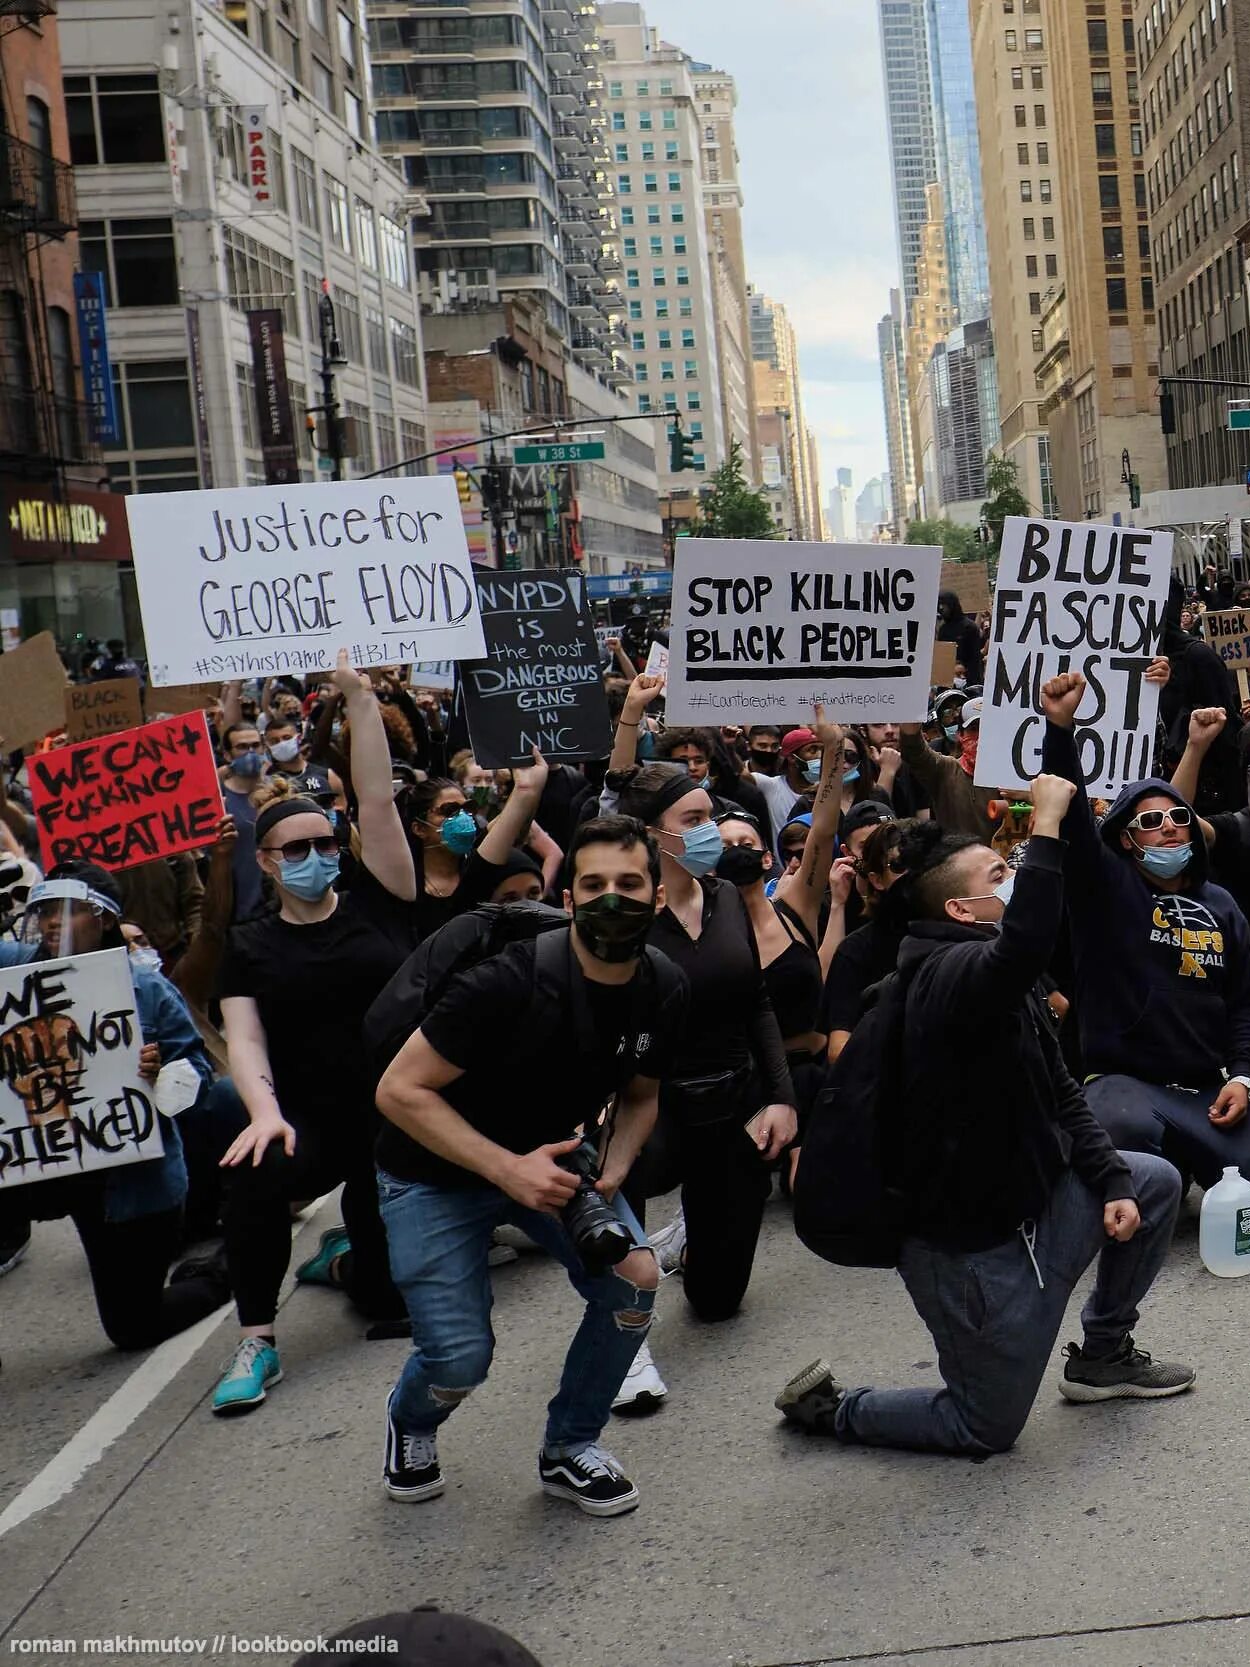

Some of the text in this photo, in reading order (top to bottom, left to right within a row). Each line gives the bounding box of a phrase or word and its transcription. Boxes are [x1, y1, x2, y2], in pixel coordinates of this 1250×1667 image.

[248, 131, 266, 186] PARK
[260, 320, 282, 436] LOVE WHERE YOU LEASE
[538, 446, 581, 460] W 38 St
[373, 494, 444, 544] for
[1017, 523, 1152, 587] BLUE
[200, 562, 474, 641] GEORGE FLOYD
[688, 575, 773, 617] STOP
[791, 567, 915, 614] KILLING
[517, 618, 545, 639] is
[686, 625, 786, 665] BLACK
[799, 620, 920, 665] PEOPLE!
[994, 590, 1168, 657] FASCISM
[1207, 613, 1248, 637] Black
[351, 640, 419, 667] #BLM
[490, 637, 587, 662] the most
[72, 688, 126, 712] BLACK
[469, 664, 599, 692] DANGEROUS
[517, 687, 577, 709] GANG
[992, 647, 1155, 731] MUST
[84, 711, 130, 729] LIVES
[520, 727, 581, 753] NYC
[34, 745, 101, 798] WE
[50, 798, 217, 866] BREATHE
[1153, 906, 1224, 953] CEFS
[0, 964, 77, 1026] WE
[68, 1008, 135, 1058] NOT
[29, 1068, 95, 1114] BE
